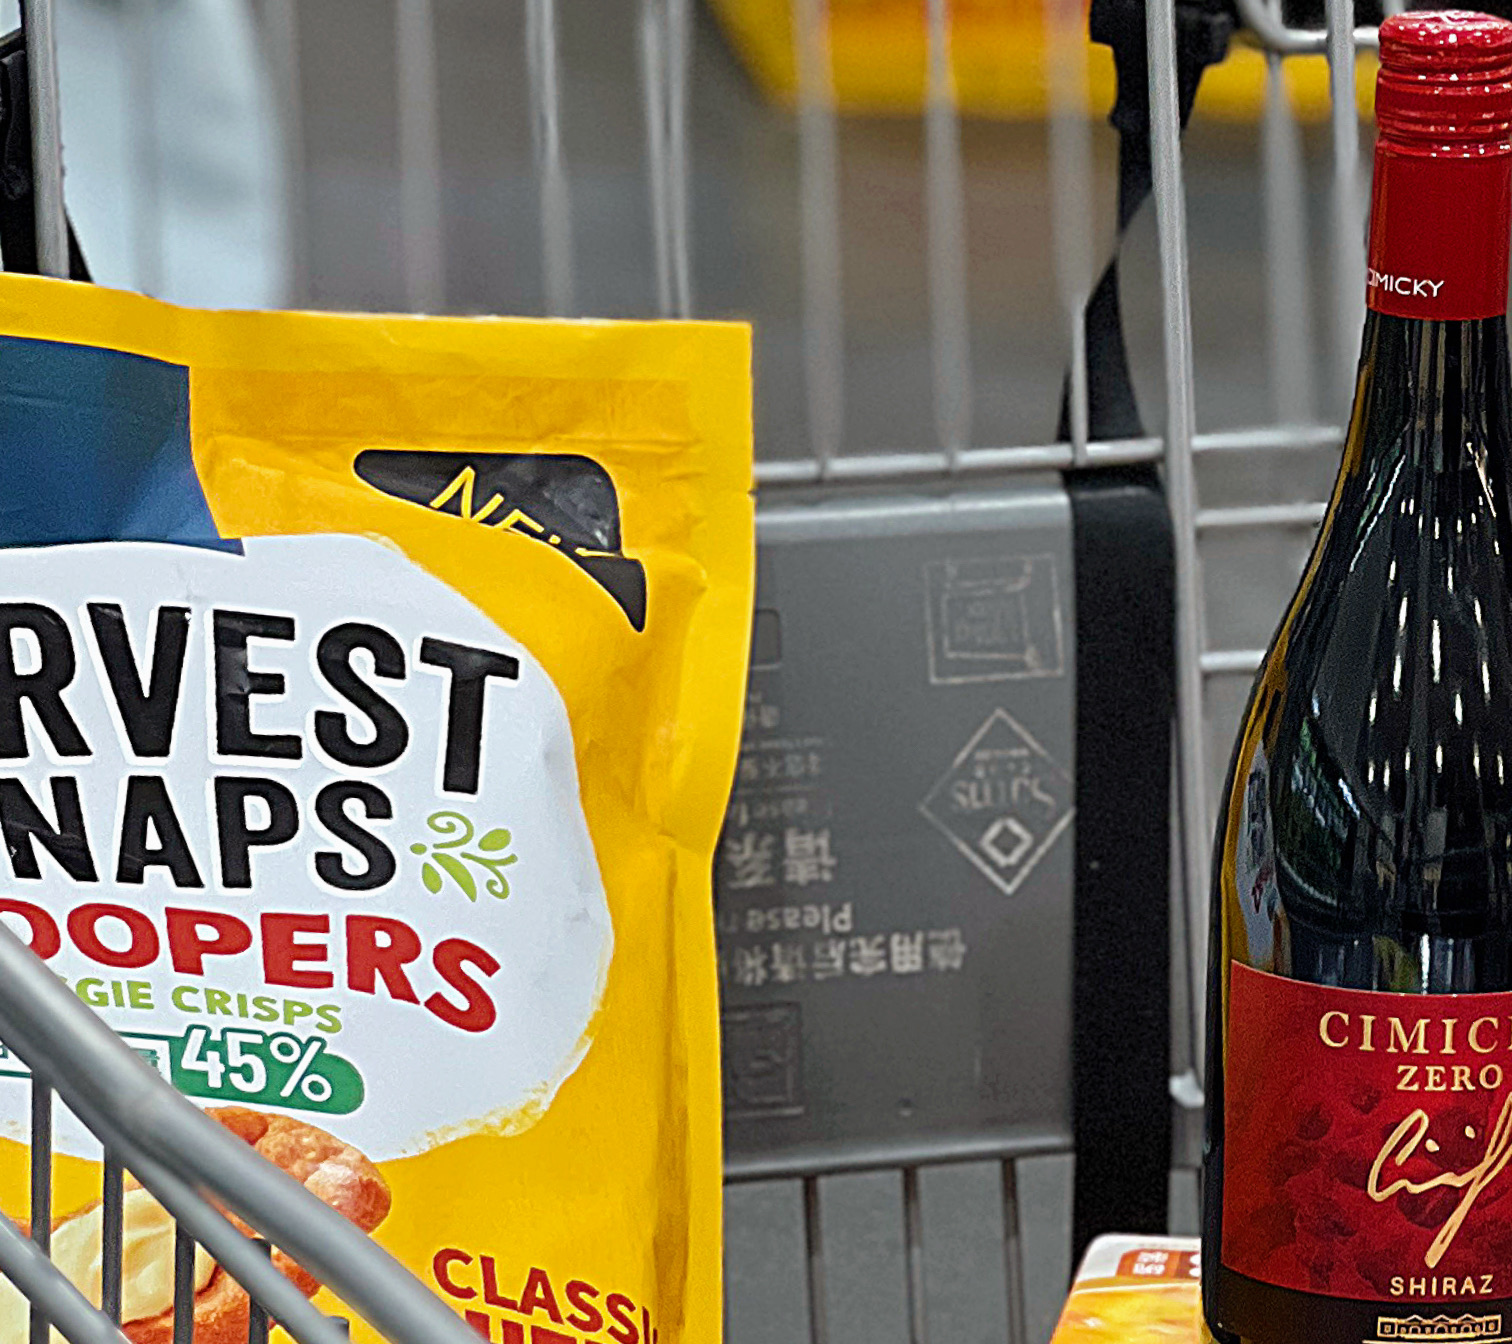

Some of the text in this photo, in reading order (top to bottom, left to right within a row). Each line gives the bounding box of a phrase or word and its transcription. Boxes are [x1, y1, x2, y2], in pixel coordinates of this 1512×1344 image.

[57, 974, 344, 1034] GIE CRISPS
[179, 1026, 334, 1103] 45%
[1396, 1064, 1504, 1093] ZERO
[1390, 1274, 1495, 1298] SHIRAZ
